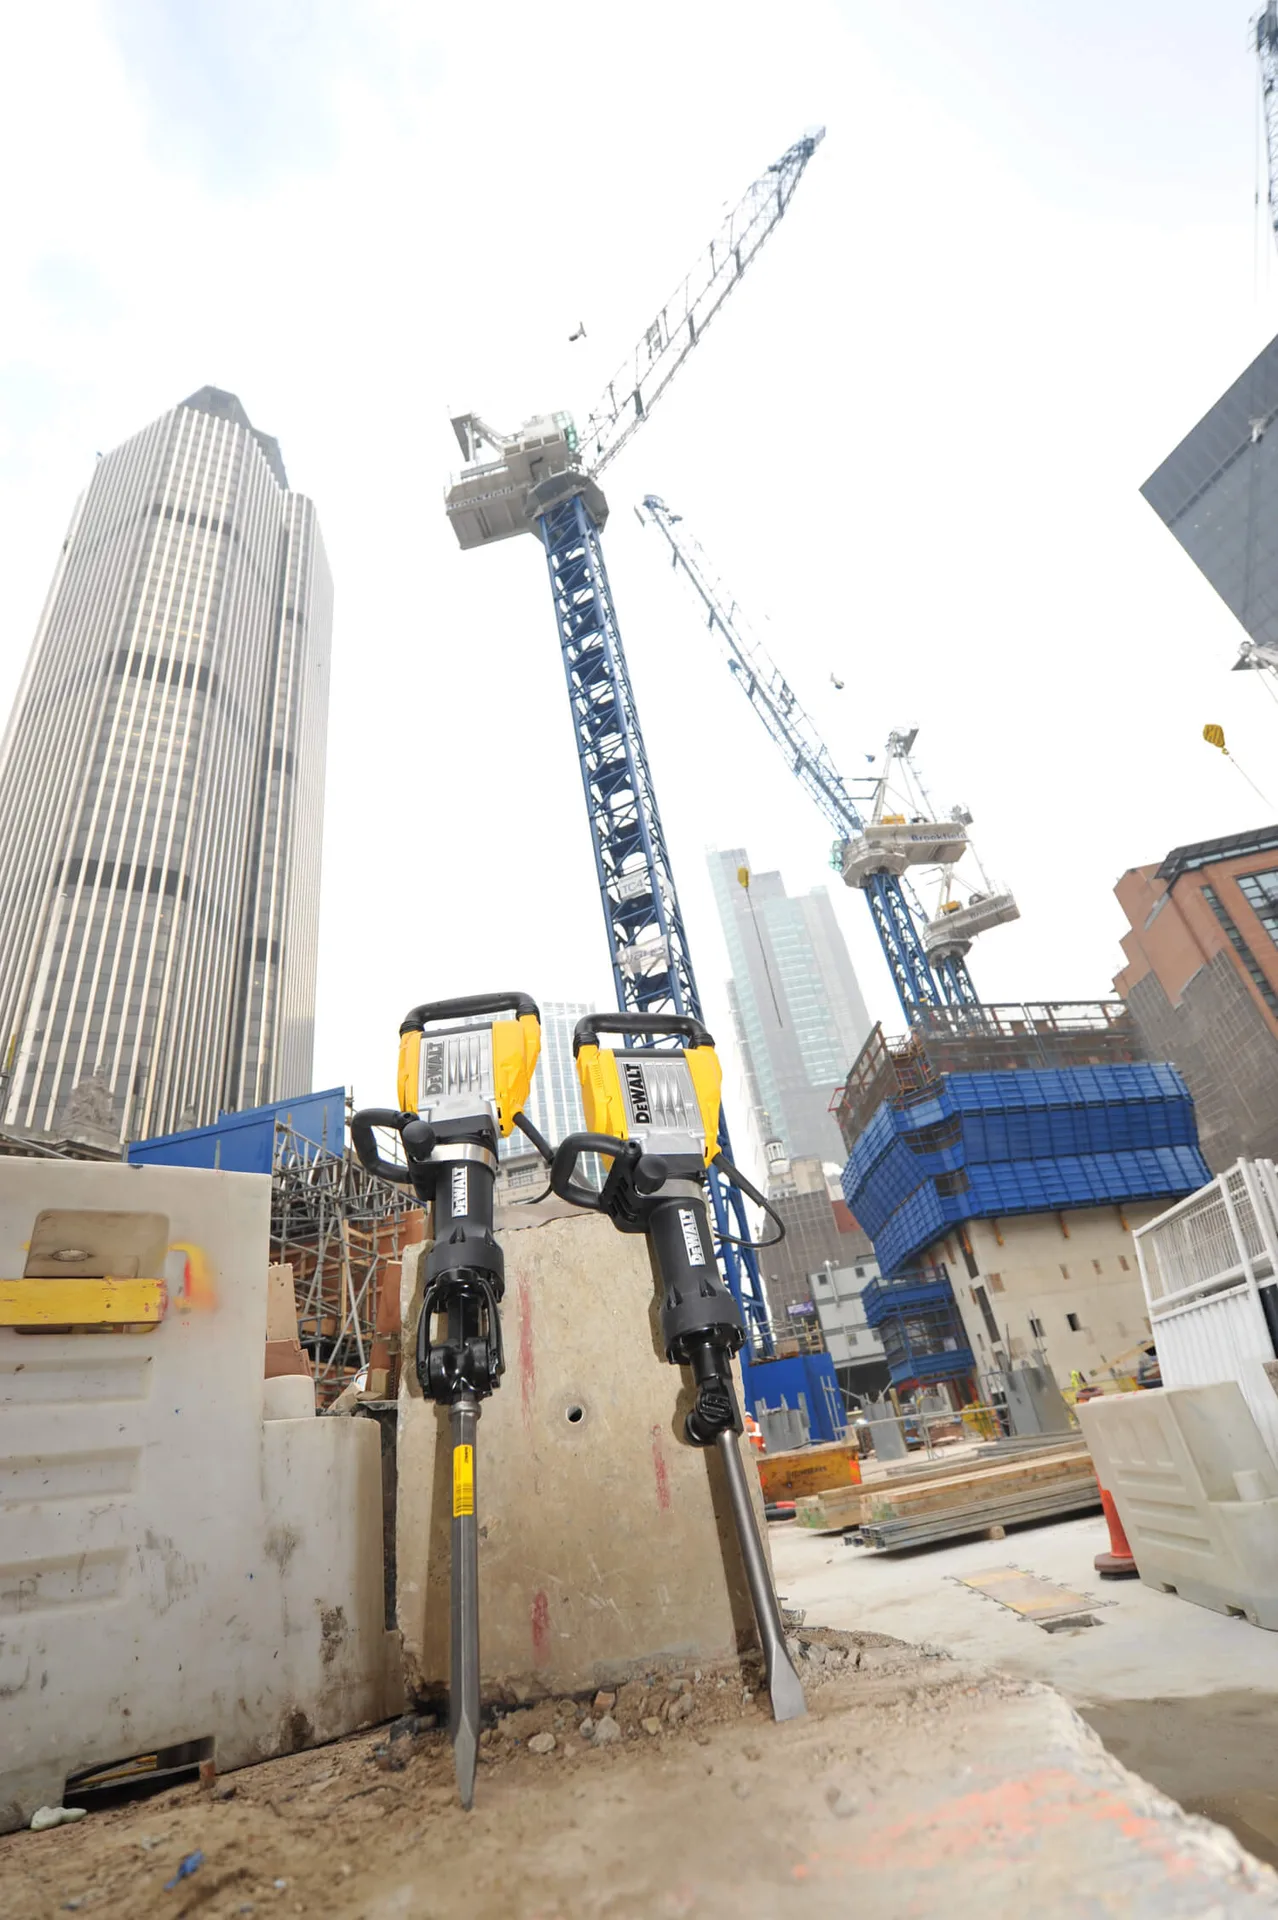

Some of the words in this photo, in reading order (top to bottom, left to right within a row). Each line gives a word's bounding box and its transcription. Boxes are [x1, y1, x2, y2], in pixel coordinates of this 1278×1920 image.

[427, 1041, 444, 1095] DEWALT
[626, 1063, 651, 1124] DEWALT
[452, 1166, 468, 1217] DEWALT
[678, 1208, 706, 1266] DEWALT
